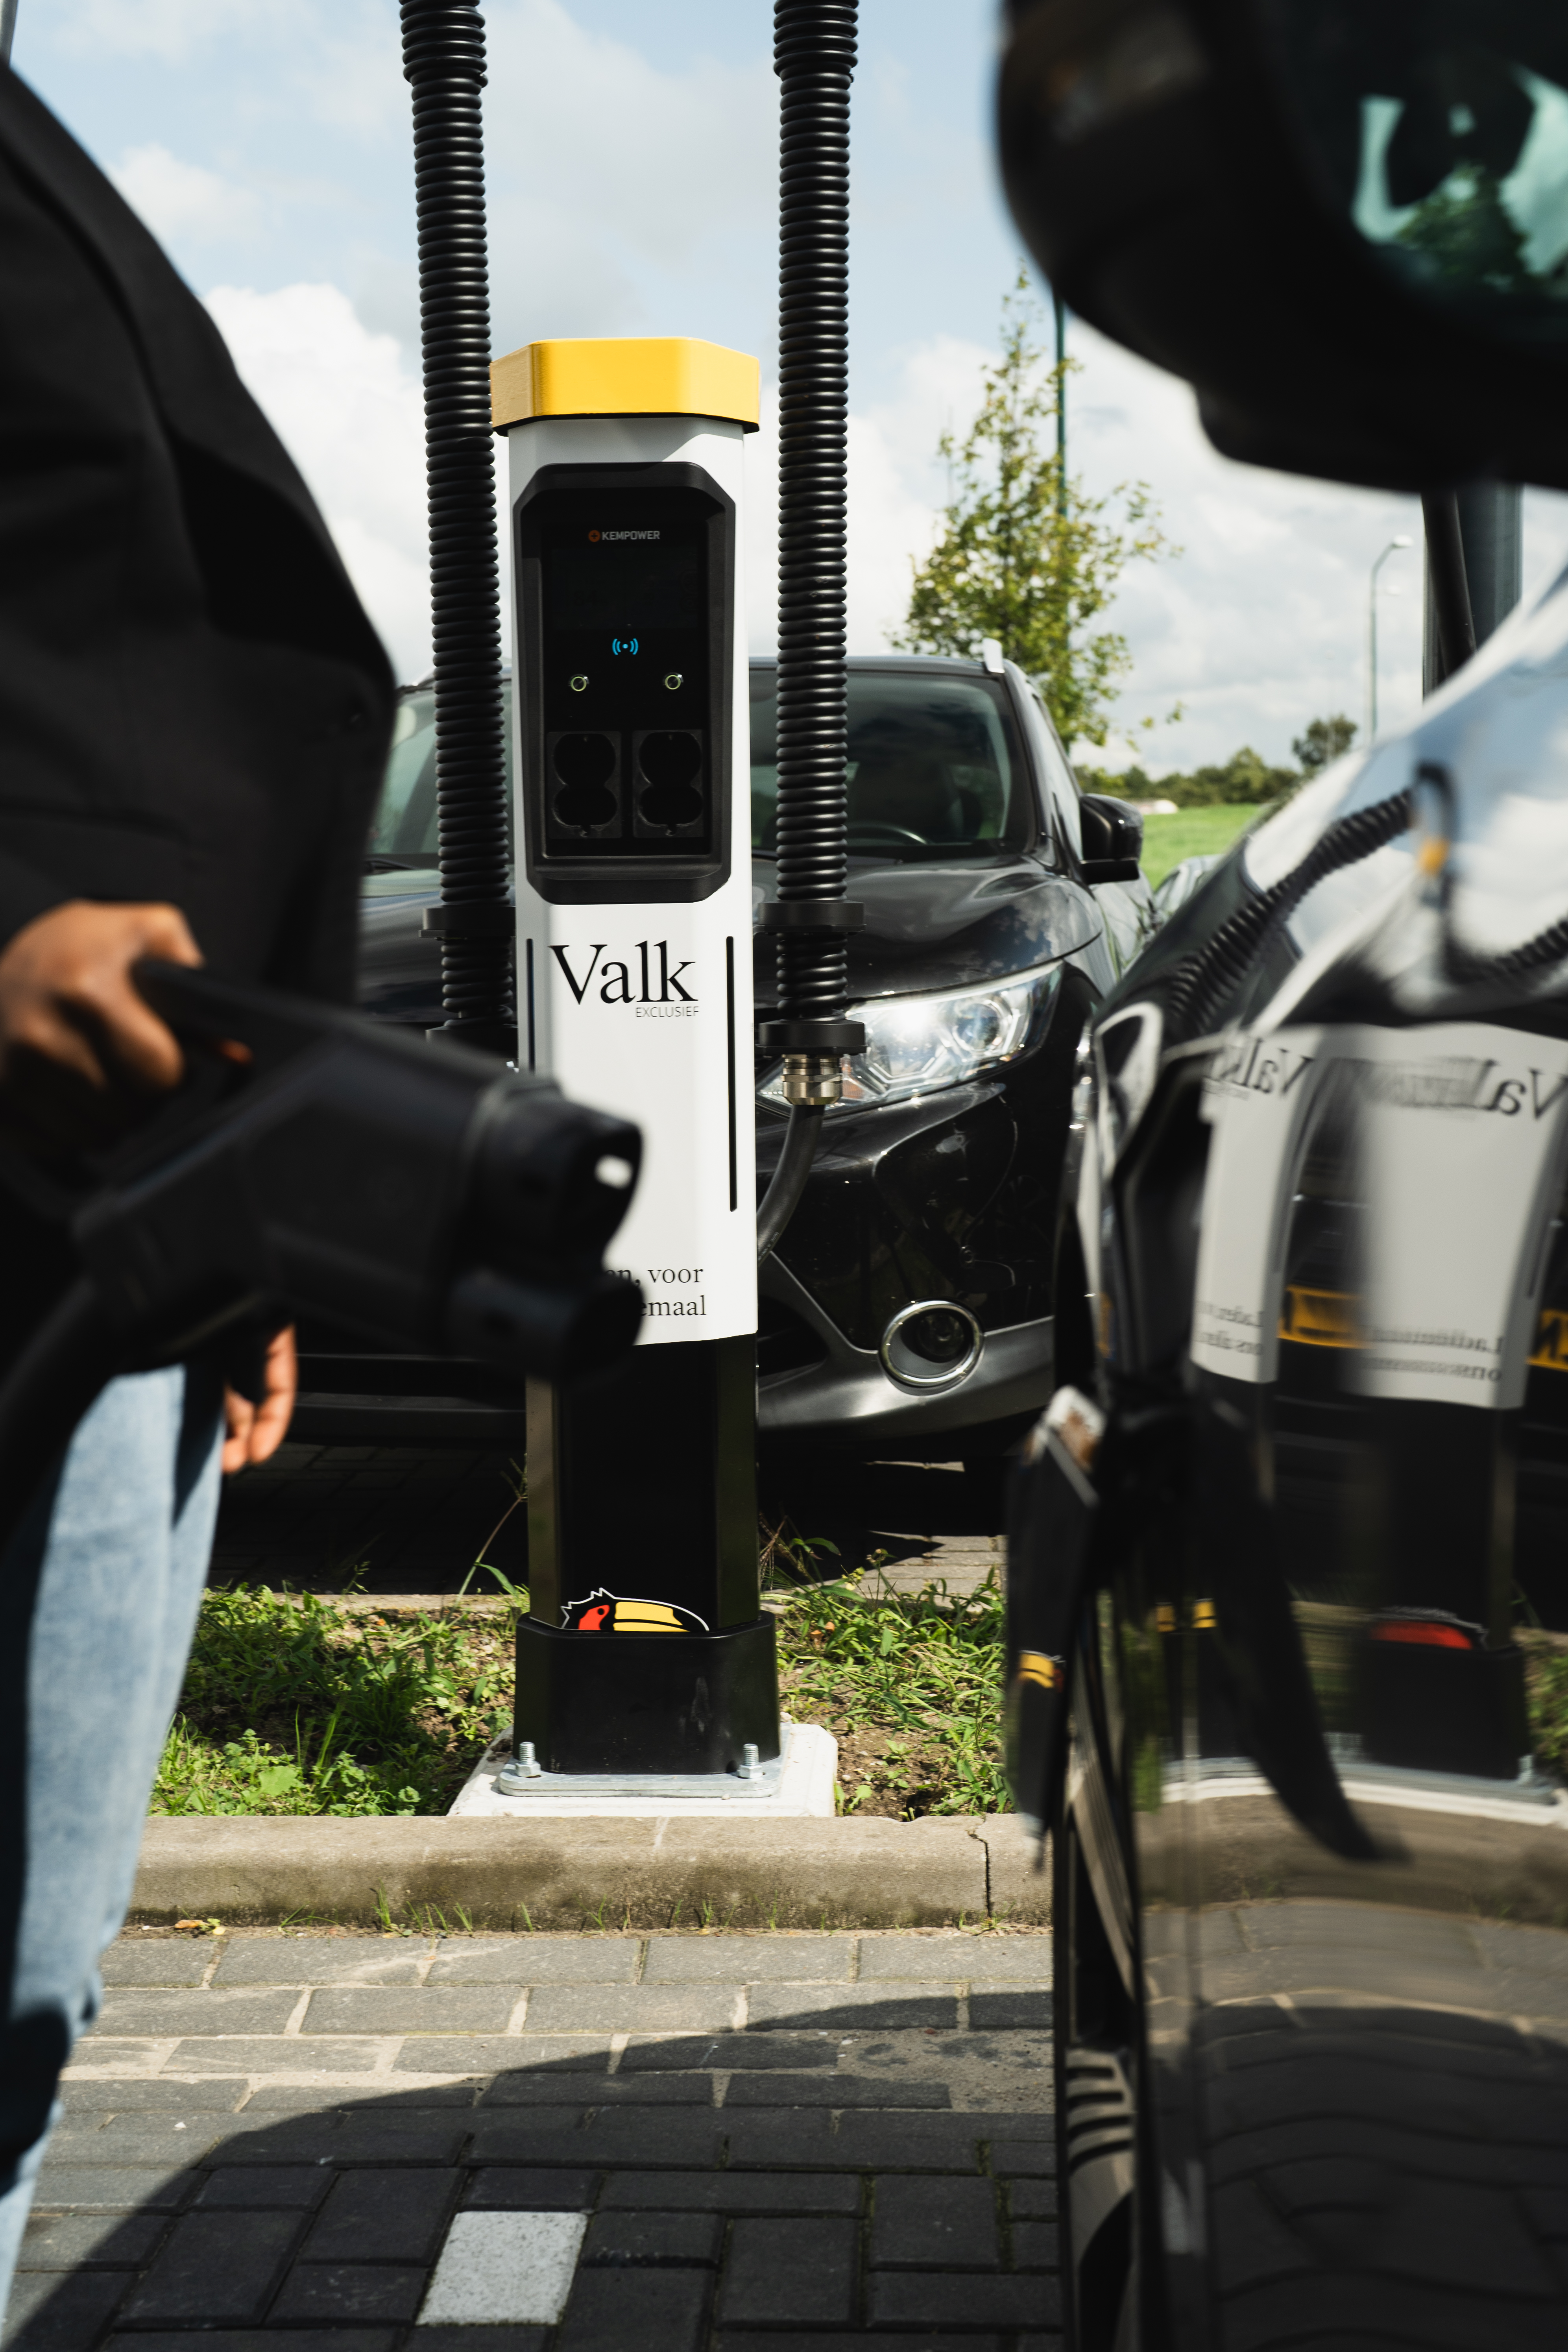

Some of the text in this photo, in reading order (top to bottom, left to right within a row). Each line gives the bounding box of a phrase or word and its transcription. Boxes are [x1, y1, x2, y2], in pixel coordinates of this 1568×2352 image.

[602, 530, 661, 540] KEMPOWER
[547, 940, 699, 1005] Valk
[635, 1006, 700, 1018] EXCLUSIEF
[647, 1269, 704, 1283] voor
